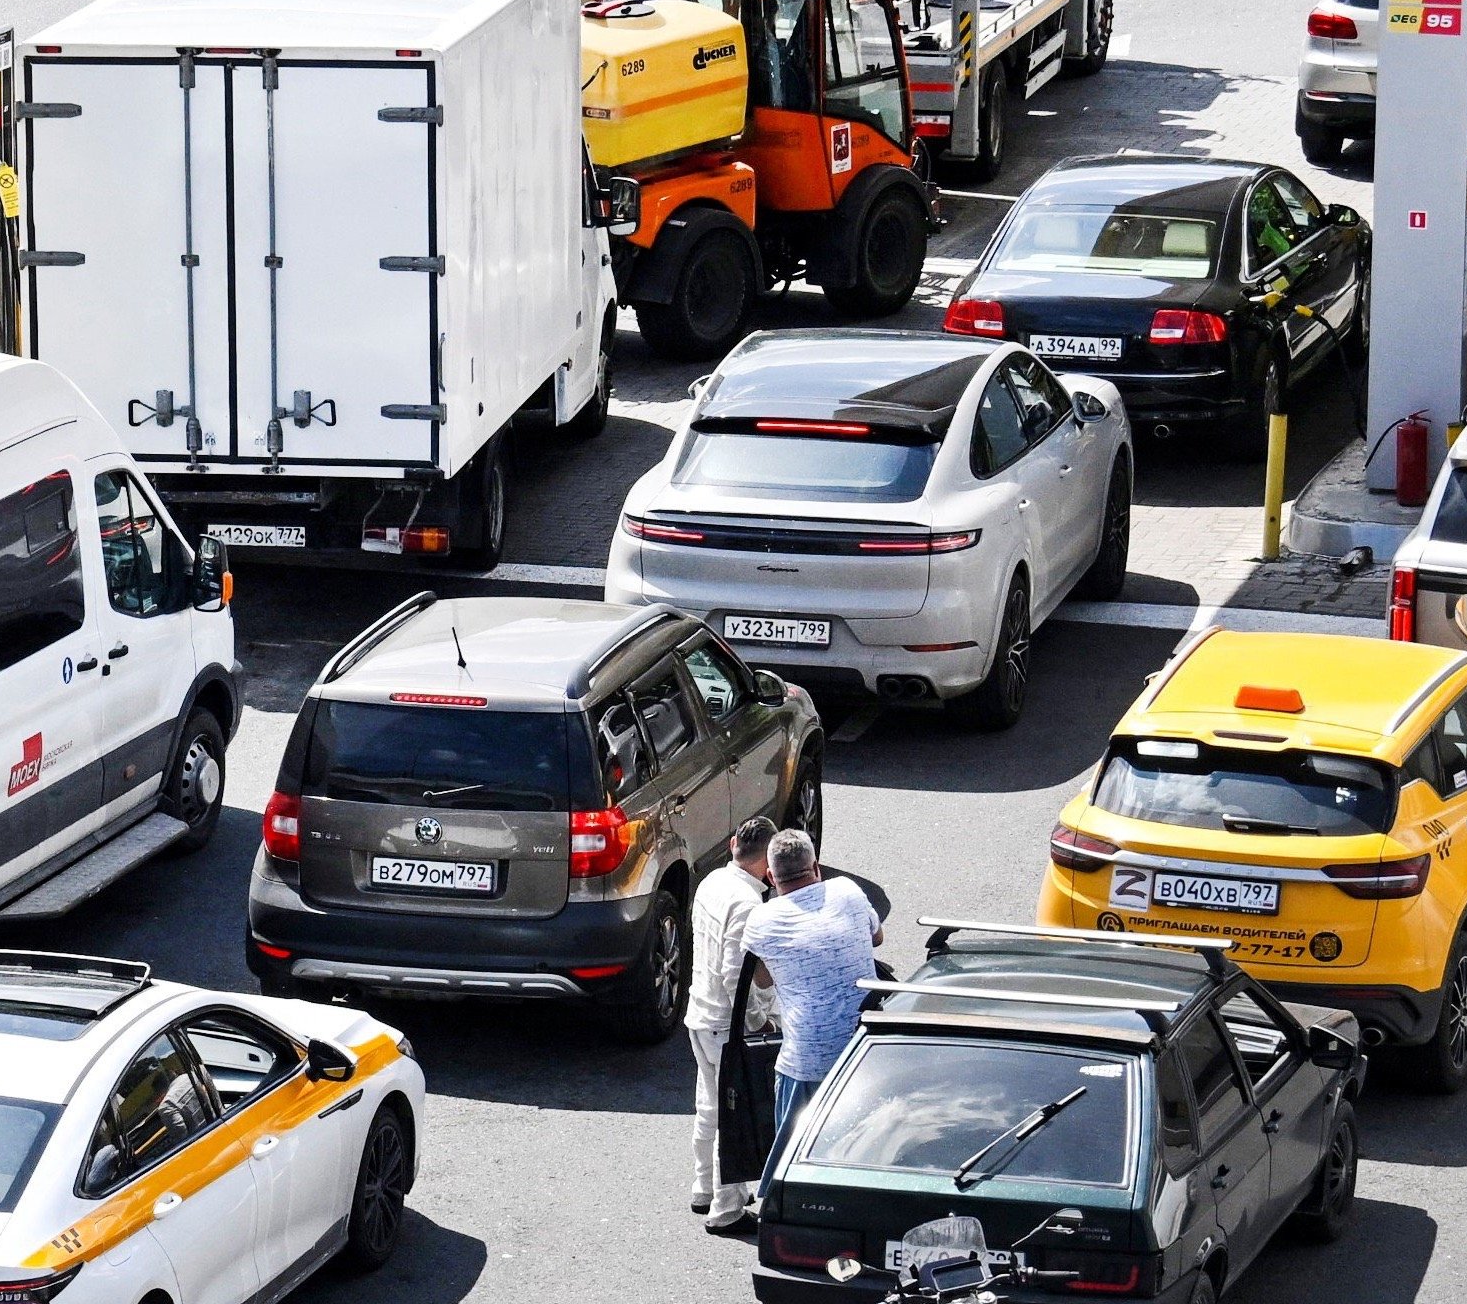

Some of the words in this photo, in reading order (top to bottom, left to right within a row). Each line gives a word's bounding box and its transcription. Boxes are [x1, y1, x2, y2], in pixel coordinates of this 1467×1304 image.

[1426, 14, 1453, 28] 95
[621, 58, 645, 77] 6289
[730, 177, 753, 193] 6289
[1035, 337, 1096, 354] А394АА
[1101, 338, 1116, 351] 99
[278, 527, 302, 540] 777
[730, 618, 797, 639] У323НТ
[799, 622, 825, 636] 799
[10, 757, 41, 790] MOEX
[1423, 819, 1447, 840] 040
[377, 862, 453, 886] В279ОМ
[456, 865, 487, 883] 797
[1115, 869, 1147, 900] Z
[1161, 879, 1237, 903] В040ХВ
[1242, 884, 1272, 901] 797
[1128, 916, 1220, 934] ПРИГЛАШАЕМ
[1223, 926, 1306, 941] ВОДИТЕЛЕЙ
[801, 1203, 835, 1212] LADA
